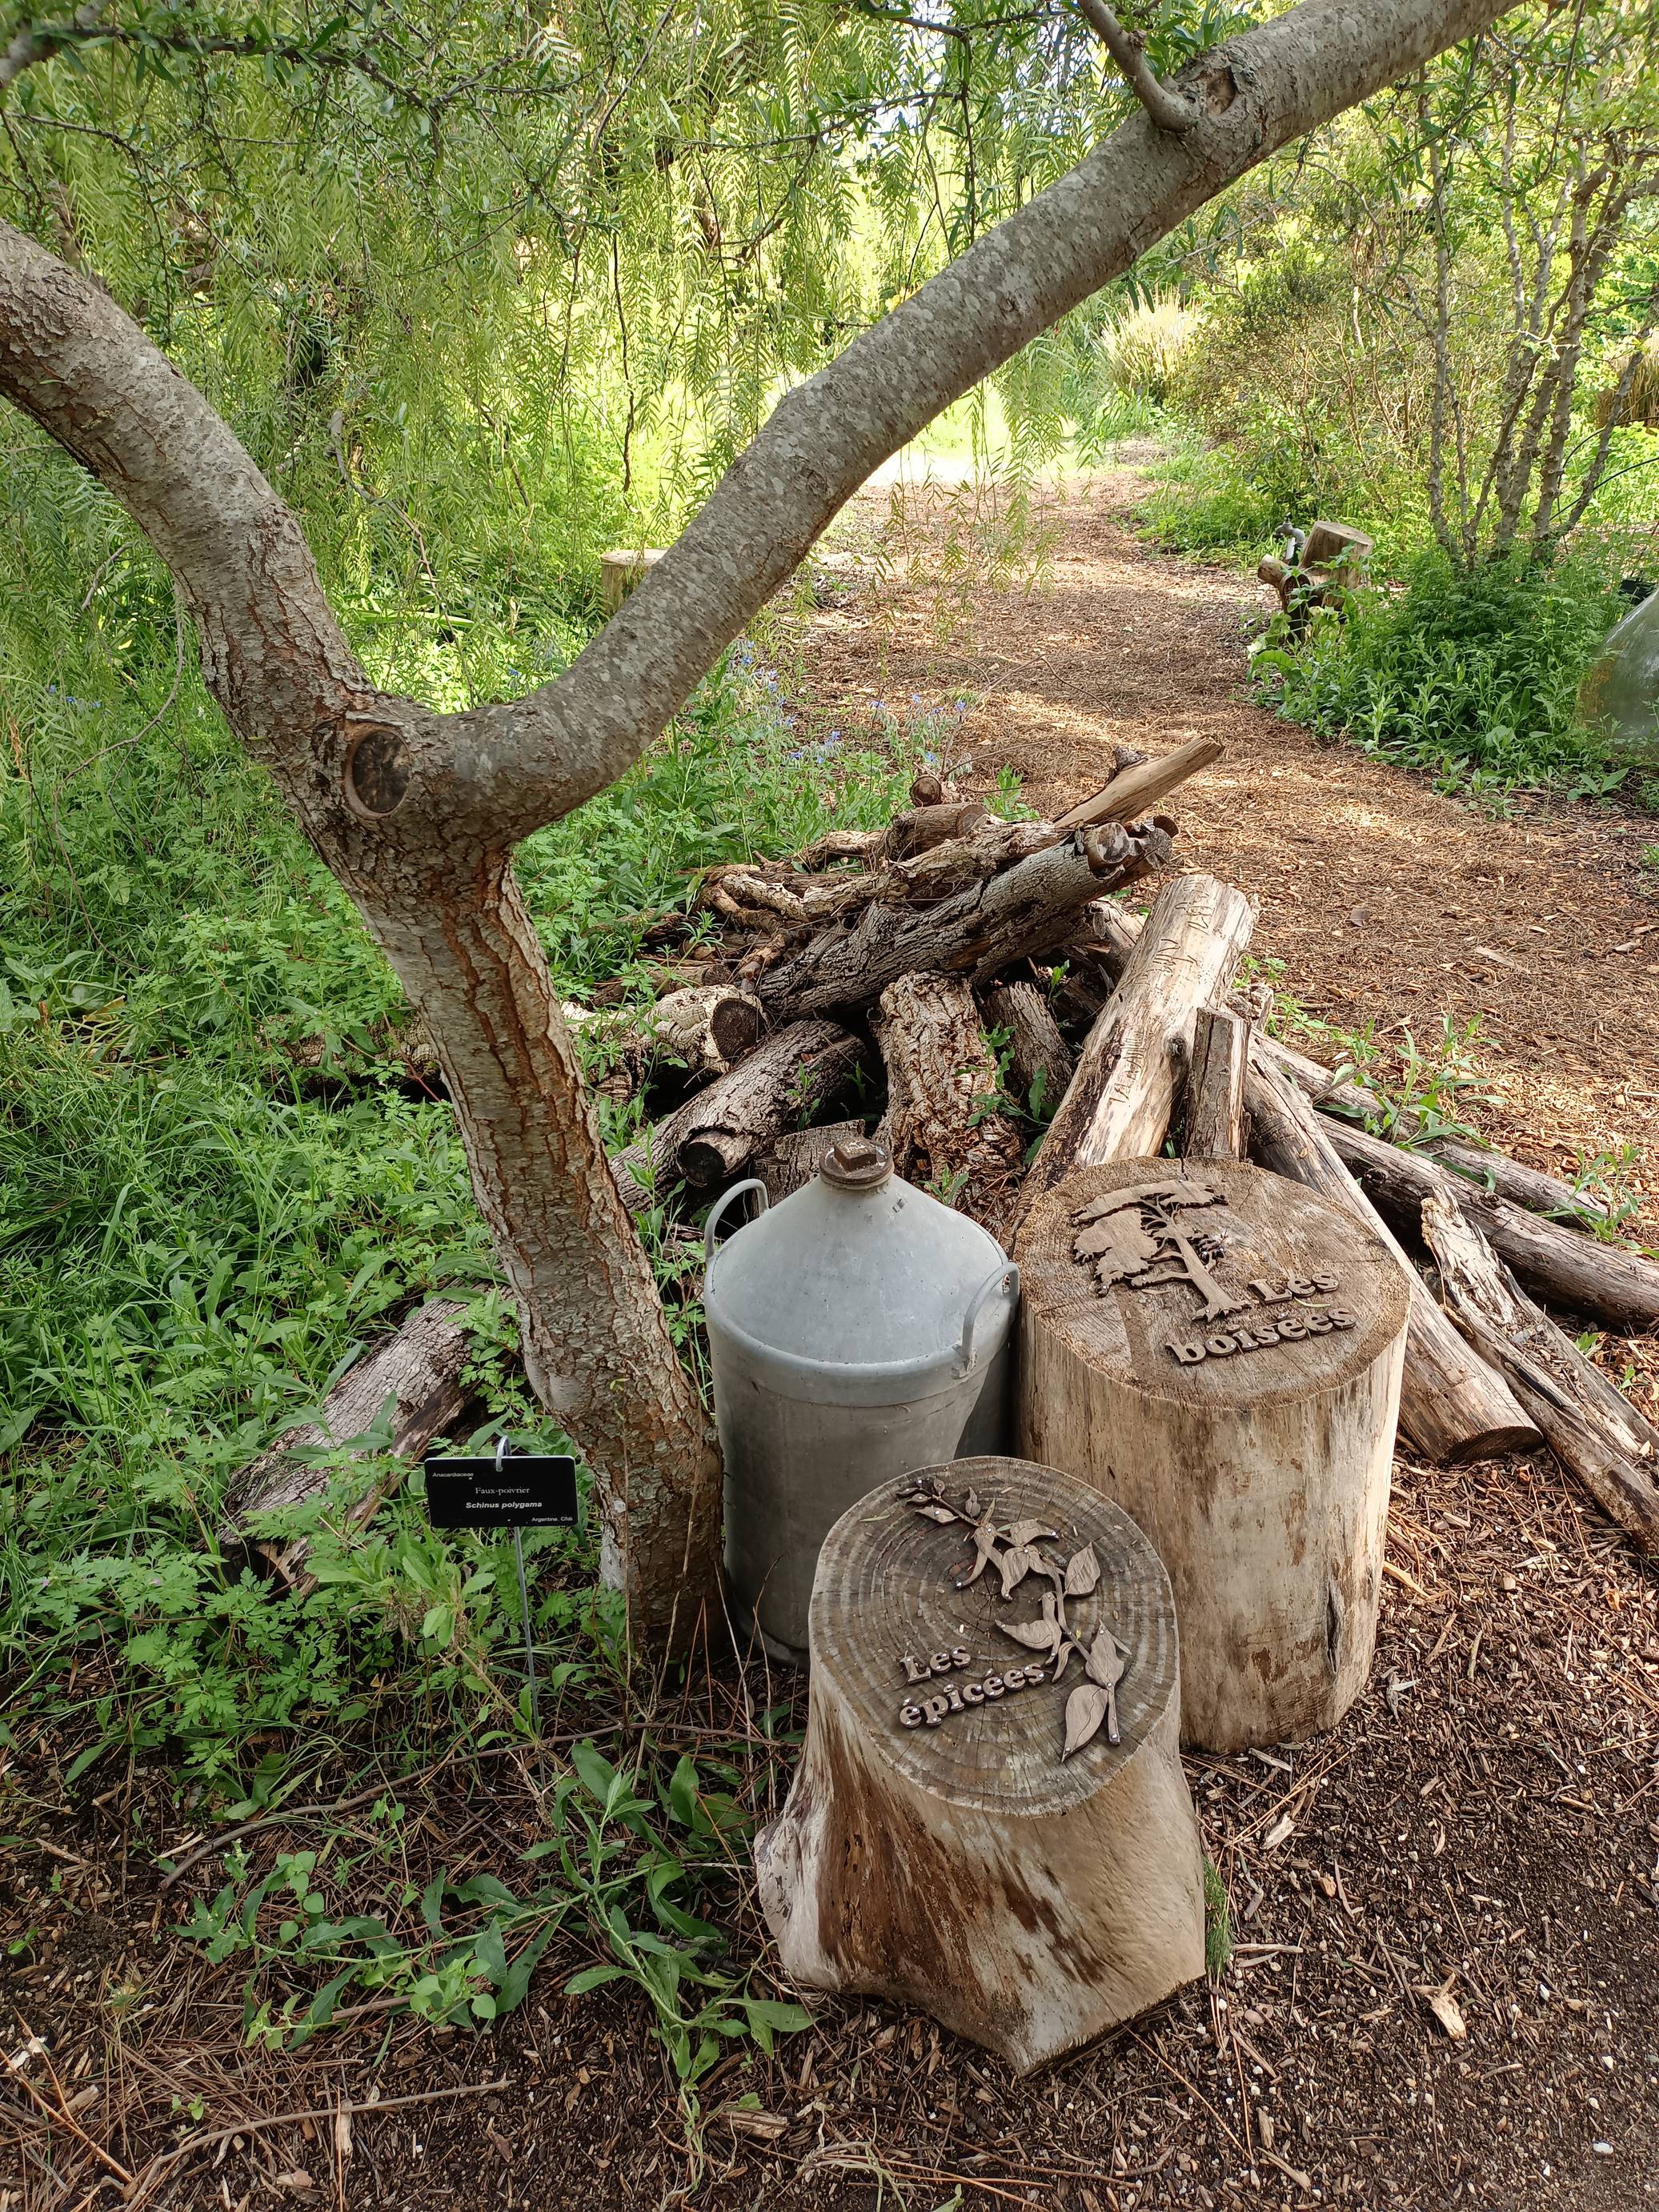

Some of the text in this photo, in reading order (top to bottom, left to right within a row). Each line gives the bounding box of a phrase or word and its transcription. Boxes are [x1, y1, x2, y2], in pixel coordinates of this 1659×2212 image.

[1248, 1272, 1340, 1305] Les
[1165, 1307, 1357, 1365] boisées
[475, 1486, 530, 1496] Faux-poivrier
[501, 1501, 543, 1509] polygama
[900, 1645, 971, 1685] Les
[900, 1662, 1045, 1729] épicées
